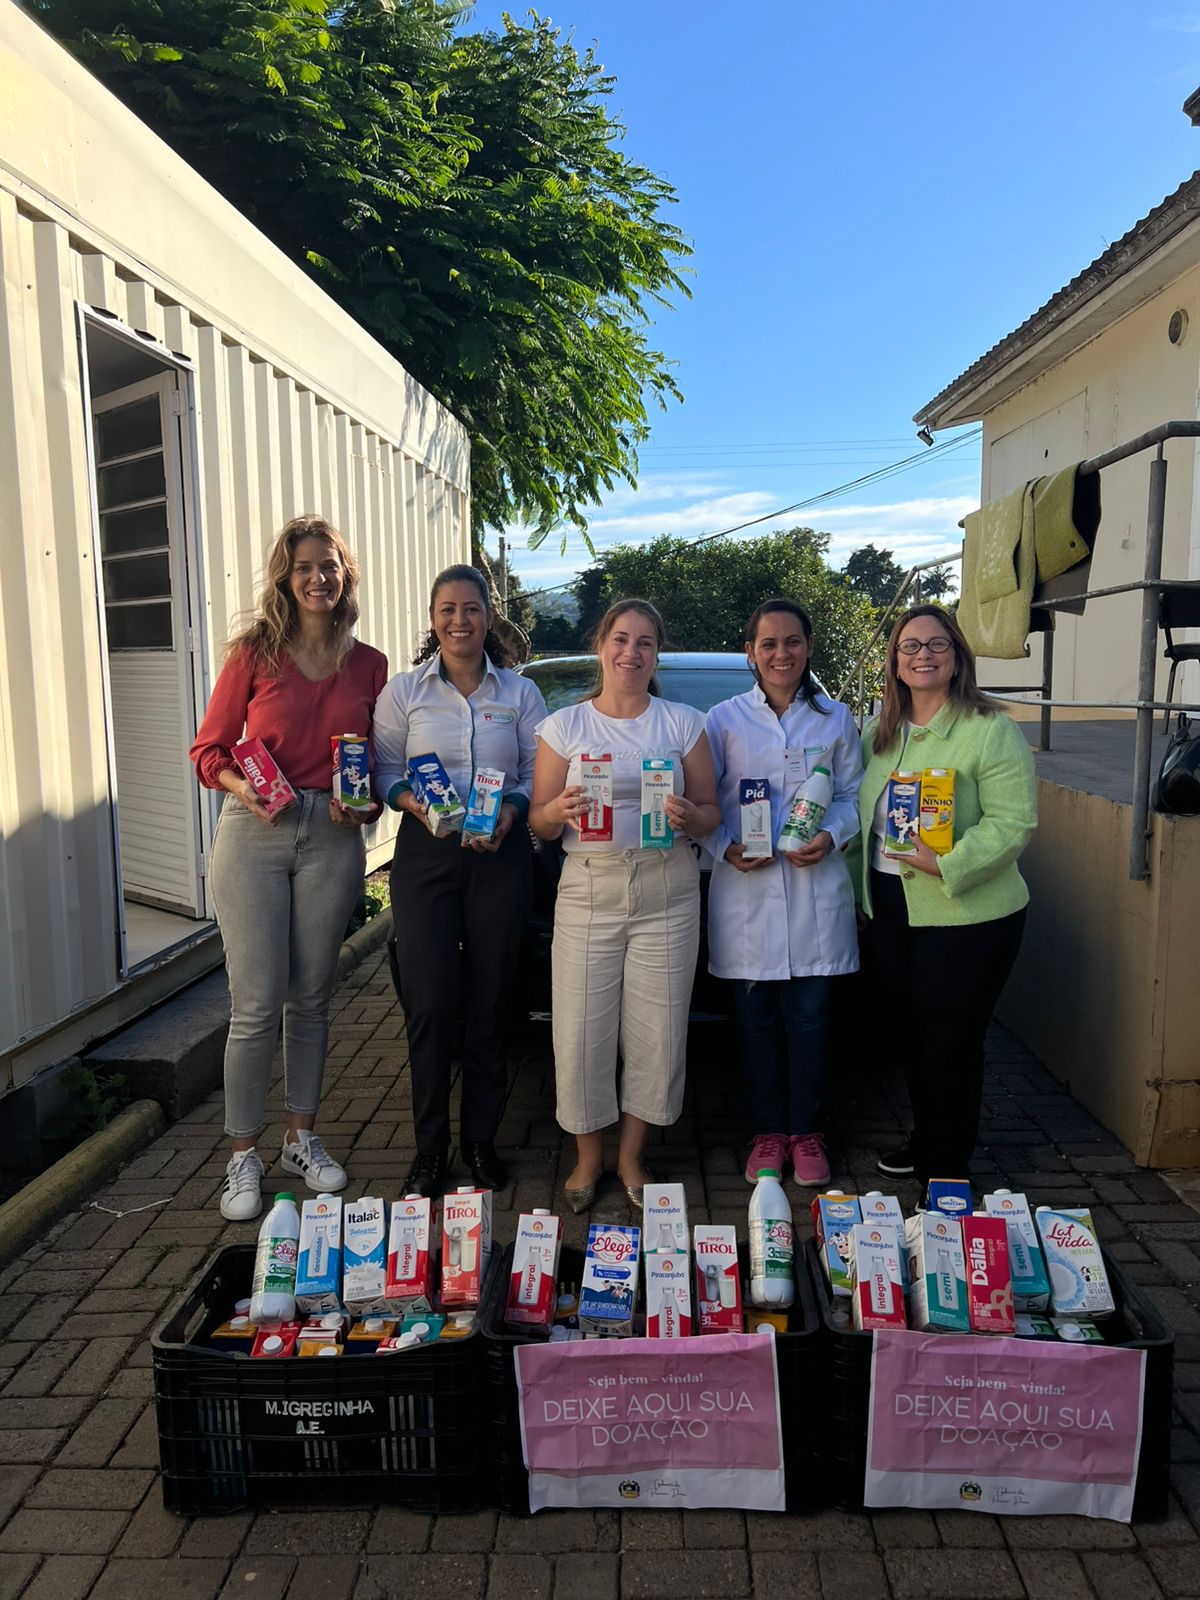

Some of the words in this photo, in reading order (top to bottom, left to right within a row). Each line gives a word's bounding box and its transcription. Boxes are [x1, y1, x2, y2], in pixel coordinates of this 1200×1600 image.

[244, 756, 267, 788] Dália
[476, 774, 501, 787] TIROL
[745, 788, 765, 798] Piá
[923, 798, 953, 806] NINHO
[445, 1207, 480, 1220] TIROL
[521, 1230, 553, 1239] Piracanjuba
[769, 1226, 793, 1245] Eleg
[1046, 1222, 1075, 1240] Lat
[272, 1244, 298, 1262] Eleg
[592, 1236, 634, 1260] Elegê
[697, 1242, 736, 1254] TIROL
[859, 1239, 894, 1250] Piracanjuba
[401, 1243, 413, 1276] integral
[970, 1237, 989, 1287] Dália
[1012, 1243, 1027, 1271] semi
[524, 1264, 536, 1299] integral
[651, 1271, 684, 1279] Piracanjuba
[940, 1271, 953, 1302] semi
[875, 1273, 887, 1309] integral
[588, 1374, 617, 1389] Seja
[619, 1373, 648, 1386] bem
[661, 1372, 704, 1385] vinda!
[944, 1374, 975, 1390] Seja
[976, 1376, 1008, 1391] bem
[1020, 1382, 1066, 1397] vinda!
[543, 1396, 618, 1422] DEIXE
[626, 1392, 691, 1418] AQUI
[699, 1390, 755, 1413] SUA
[895, 1393, 972, 1418] DEIXE
[979, 1399, 1049, 1426] AQUI
[1058, 1407, 1114, 1431] SUA
[592, 1416, 709, 1447] DOAÇÃO
[940, 1424, 1063, 1451] DOAÇÃO
